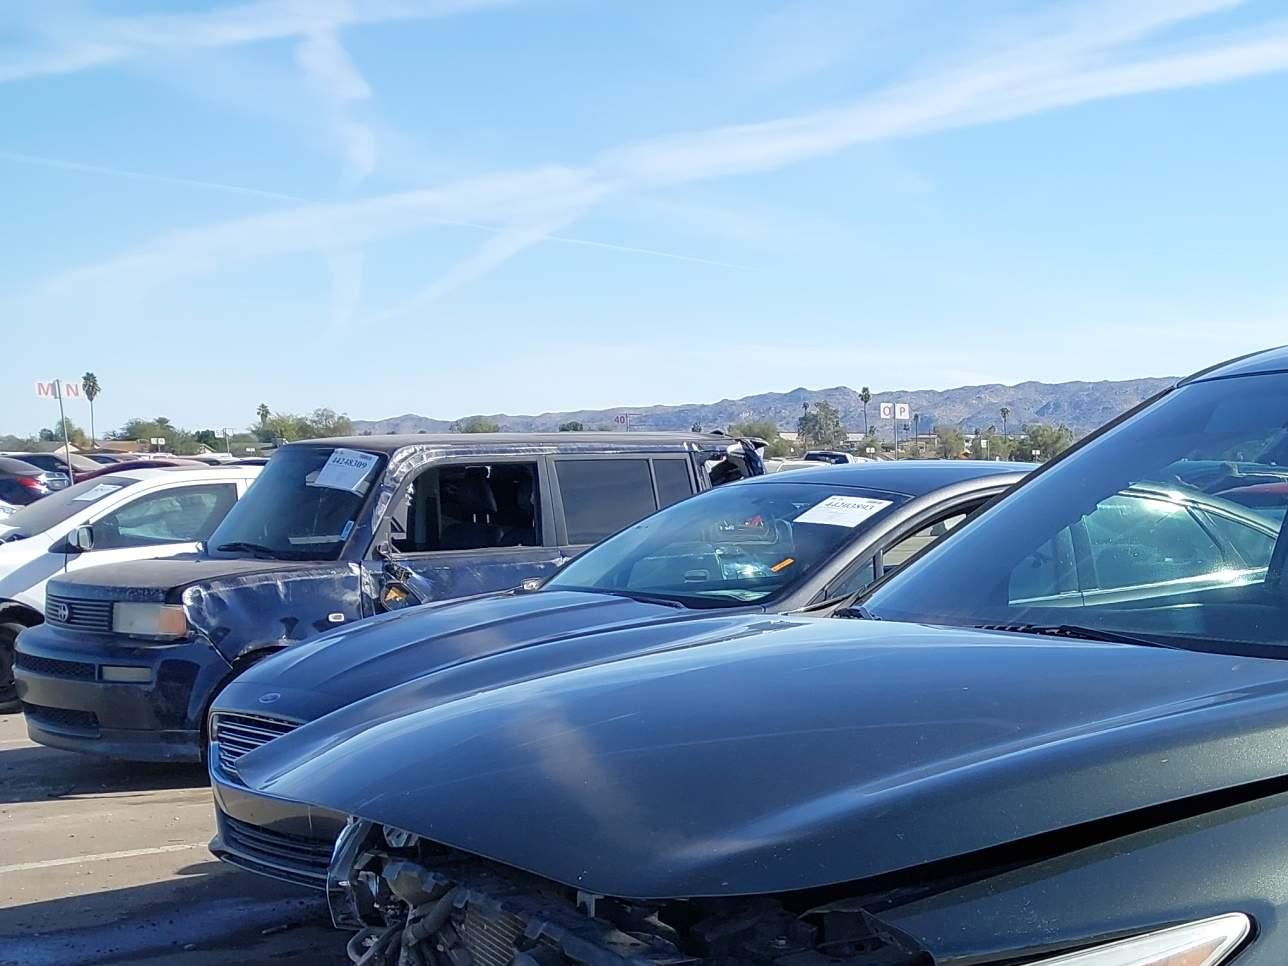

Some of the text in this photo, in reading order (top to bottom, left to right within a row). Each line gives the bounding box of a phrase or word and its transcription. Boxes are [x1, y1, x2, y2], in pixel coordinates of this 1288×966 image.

[38, 383, 79, 397] M N
[900, 407, 906, 417] P
[614, 416, 625, 424] 40
